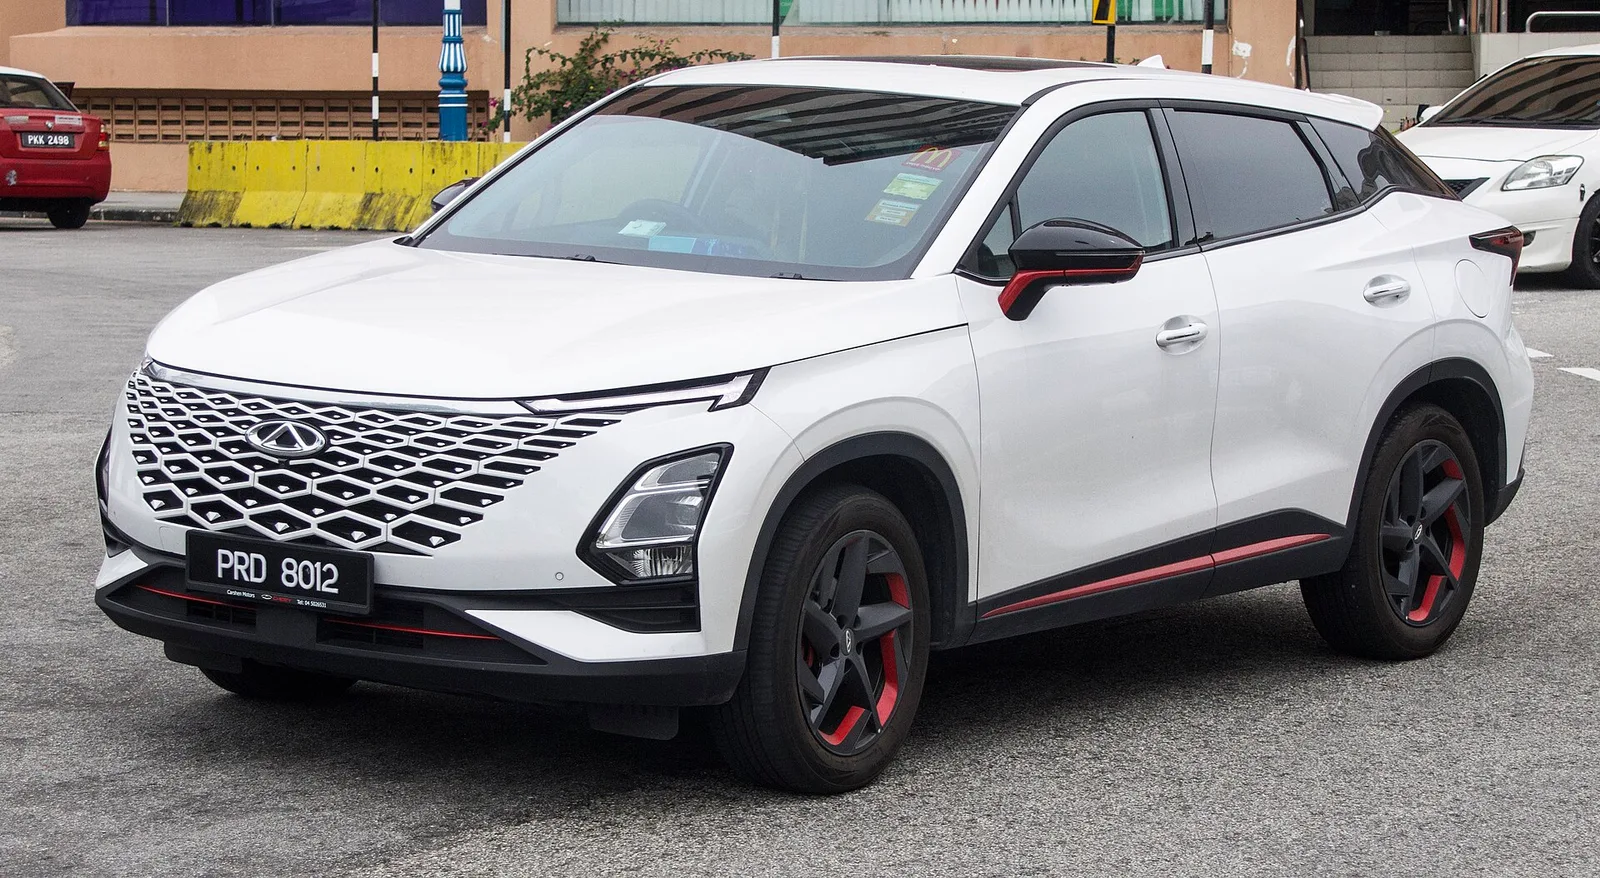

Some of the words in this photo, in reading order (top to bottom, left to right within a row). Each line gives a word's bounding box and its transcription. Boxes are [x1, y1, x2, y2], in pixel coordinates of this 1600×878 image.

[28, 135, 45, 145] PKK
[47, 135, 69, 145] 2498
[217, 549, 267, 583] PRD
[281, 557, 339, 594] 8012
